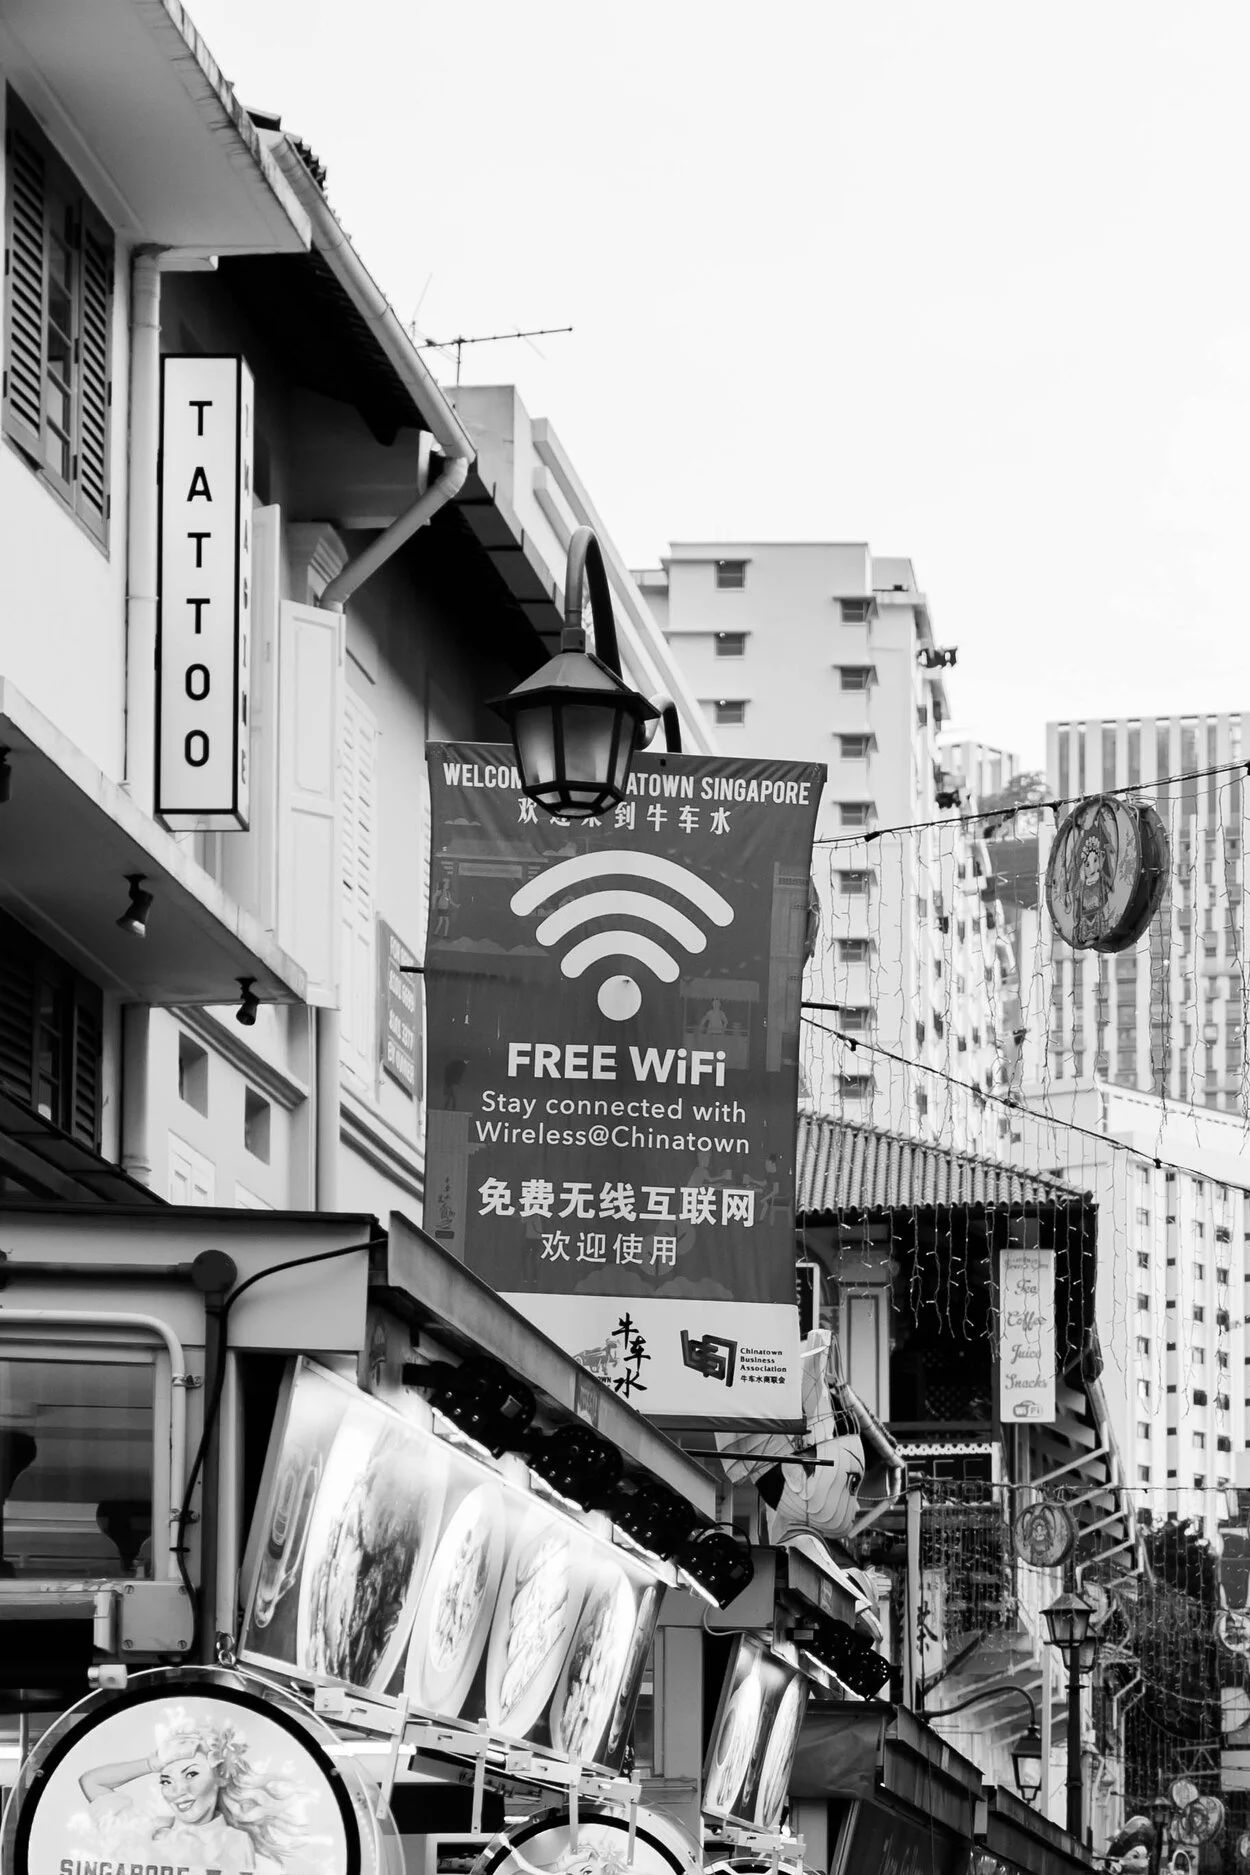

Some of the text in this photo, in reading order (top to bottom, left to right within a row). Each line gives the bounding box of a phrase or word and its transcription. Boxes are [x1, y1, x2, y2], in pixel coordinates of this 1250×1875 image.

[183, 400, 213, 767] TATTOO
[443, 762, 811, 805] WELCOM ATOWN SINGAPORE
[507, 1042, 726, 1087] FREE WiFi
[481, 1090, 746, 1123] Stay connected with
[475, 1120, 750, 1154] Wireless@Chinatown
[478, 1177, 755, 1227] 免费无线互联网
[540, 1230, 677, 1266] 欢迎使用
[1007, 1311, 1047, 1331] Coffee
[740, 1348, 783, 1356] Chinatown
[740, 1356, 775, 1364] Business
[1011, 1344, 1041, 1364] Juice
[740, 1365, 787, 1373] Association
[1005, 1373, 1048, 1389] Snacks
